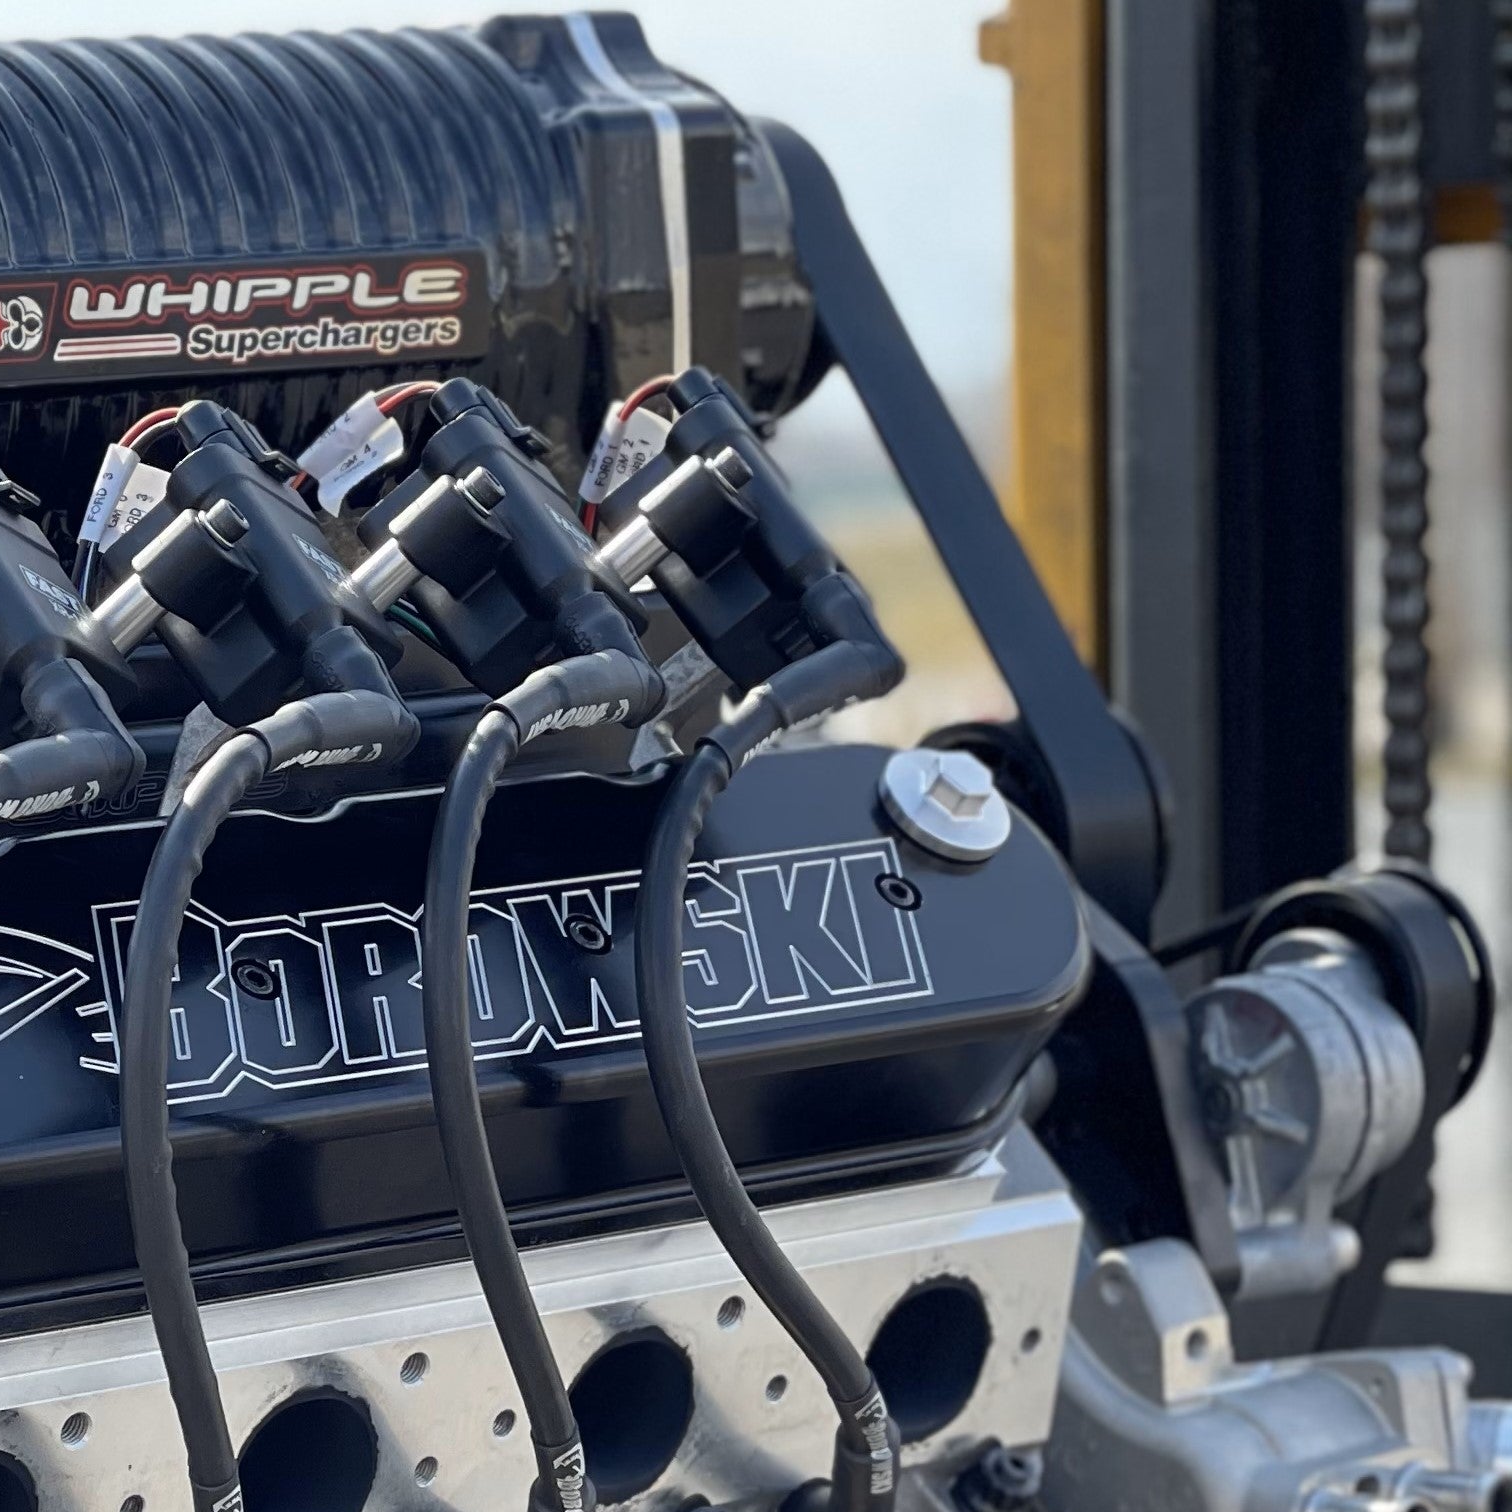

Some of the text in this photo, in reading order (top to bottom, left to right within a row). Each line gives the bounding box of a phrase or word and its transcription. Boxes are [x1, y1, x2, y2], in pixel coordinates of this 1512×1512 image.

[68, 267, 462, 320] WHIPPLE
[189, 317, 459, 362] Superchargers
[87, 472, 113, 522] FORD 3
